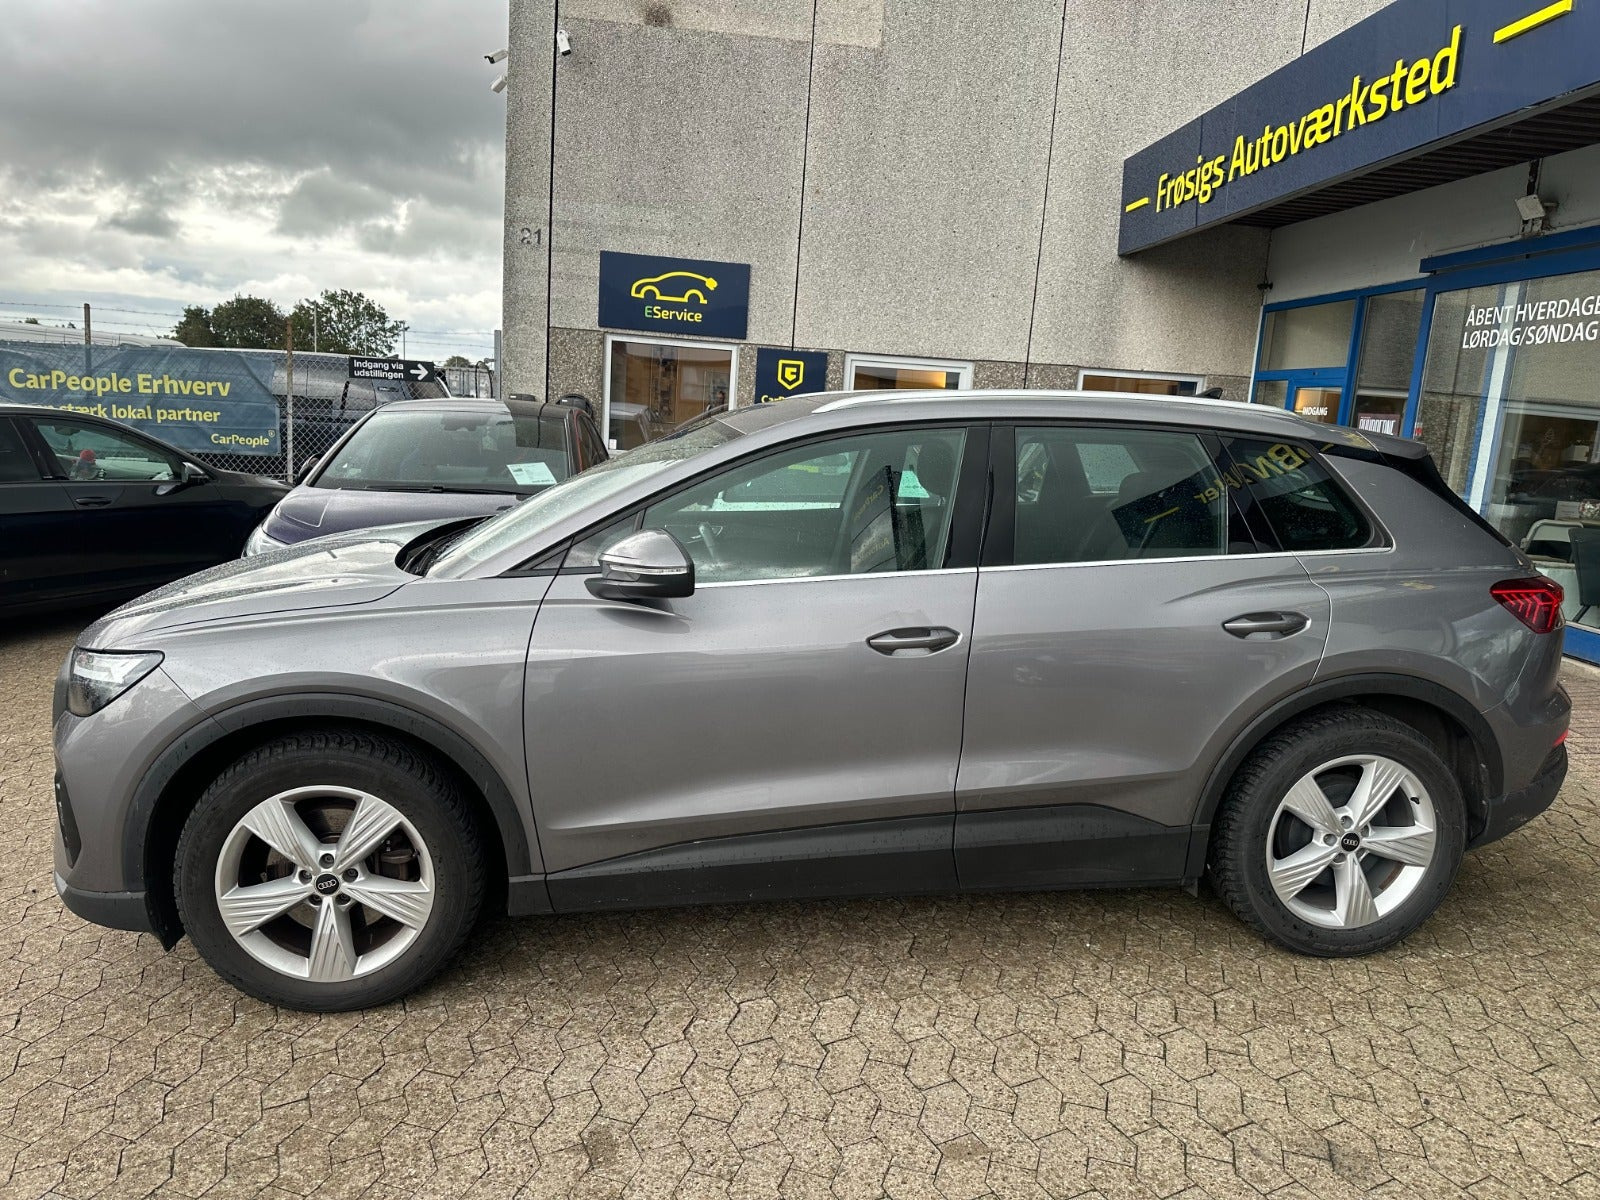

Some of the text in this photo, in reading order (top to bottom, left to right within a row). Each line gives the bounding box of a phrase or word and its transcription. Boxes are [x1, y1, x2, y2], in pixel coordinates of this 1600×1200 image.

[1156, 24, 1463, 213] Frøsigs Autoværksted
[520, 227, 542, 245] 21
[644, 305, 703, 323] EService
[1465, 304, 1514, 327] ÅBENT
[1462, 320, 1600, 349] LØRDAG/SØNDAG
[353, 359, 404, 370] Indgang via
[8, 368, 231, 397] CarPeople Erhverv
[353, 369, 404, 379] udstillingen
[112, 404, 152, 420] lokal
[156, 407, 221, 423] partner
[210, 433, 270, 448] CarPeople
